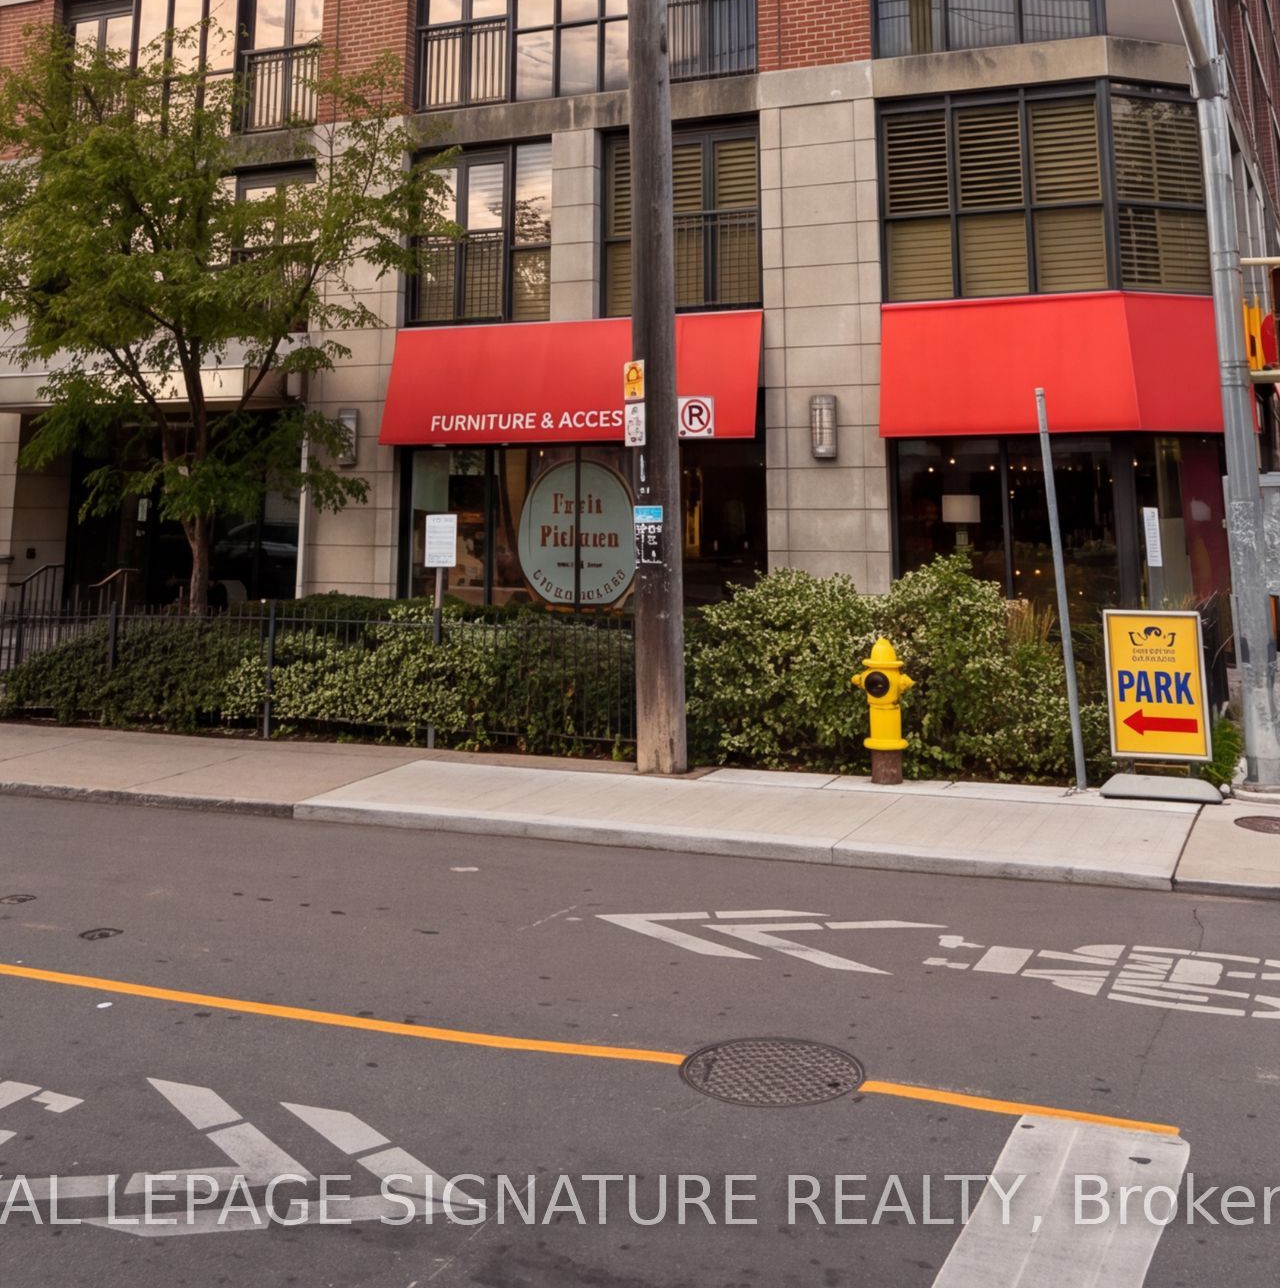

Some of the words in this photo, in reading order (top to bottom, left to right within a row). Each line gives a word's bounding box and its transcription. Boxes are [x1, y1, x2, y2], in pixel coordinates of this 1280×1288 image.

[431, 412, 536, 432] FURNITURE
[540, 412, 554, 429] &
[558, 410, 623, 428] ACCES
[1117, 670, 1195, 705] PARK
